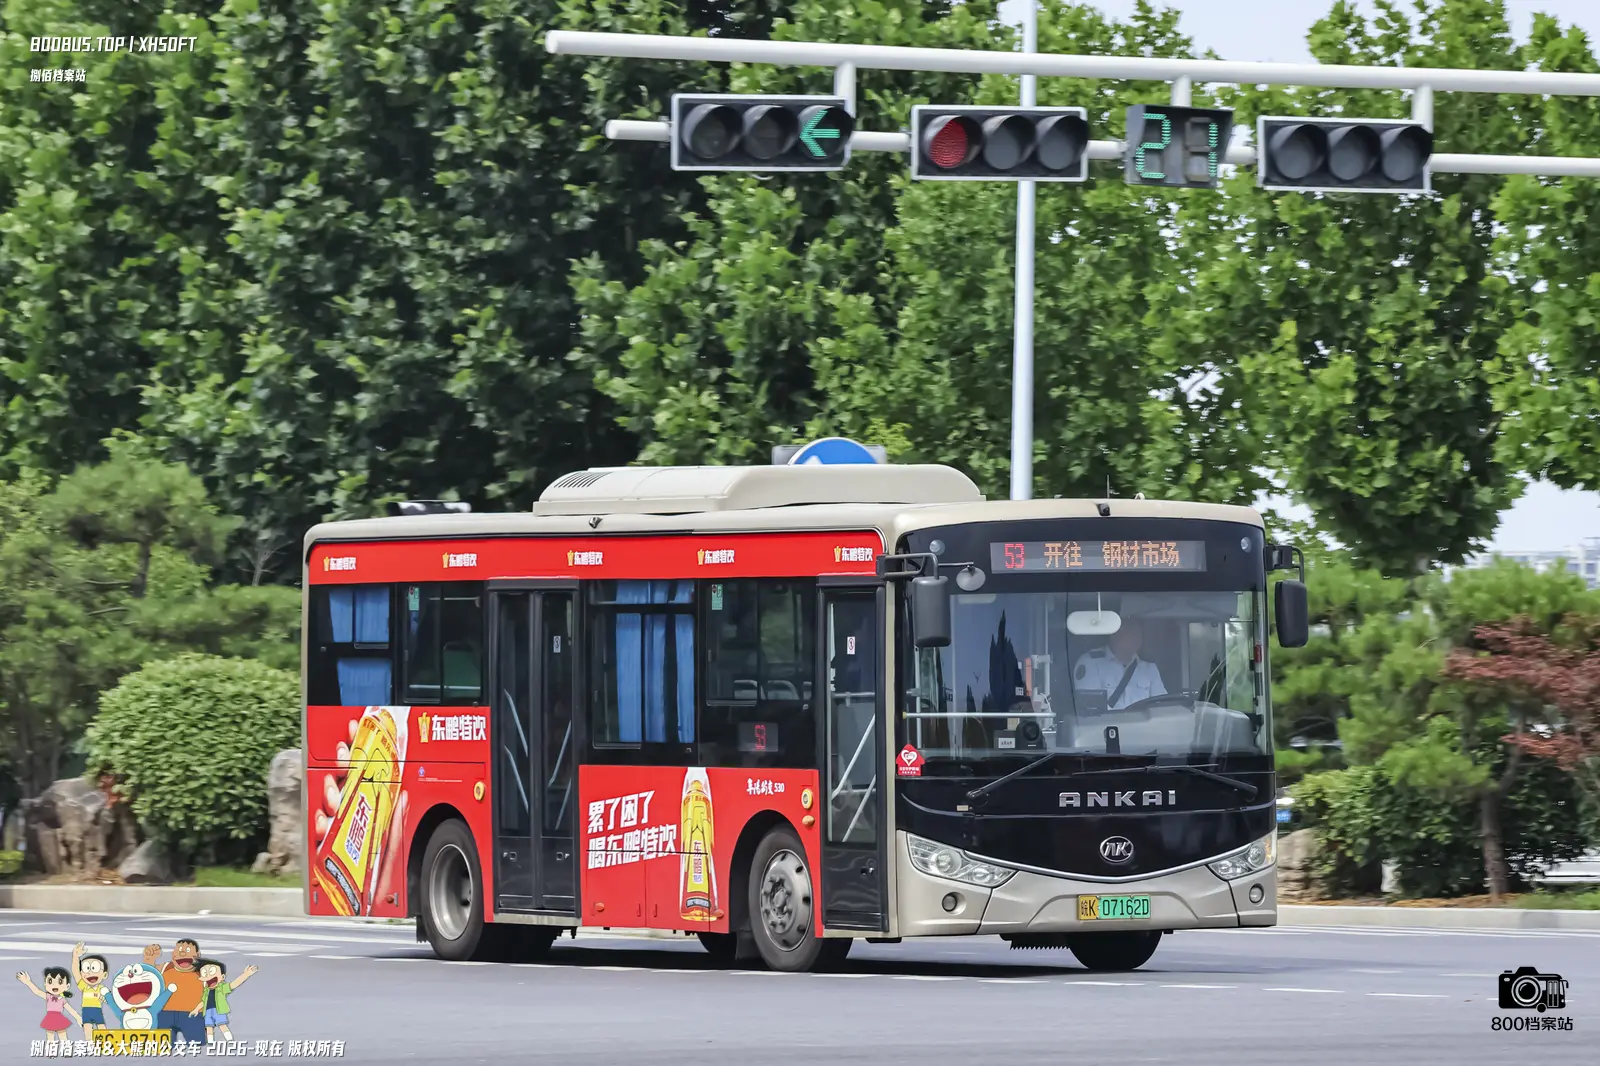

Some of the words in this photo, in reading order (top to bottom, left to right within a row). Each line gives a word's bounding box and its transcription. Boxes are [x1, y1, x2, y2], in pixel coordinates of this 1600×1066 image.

[1135, 112, 1219, 178] 21
[1004, 543, 1025, 569] 53
[1043, 541, 1083, 569] 开往
[1102, 540, 1181, 568] 钢材市场
[431, 714, 486, 741] 东鹏特饮
[587, 790, 656, 835] 累了困了
[1059, 790, 1176, 808] ANKAI
[587, 823, 678, 870] 喝东鹏特饮
[1102, 898, 1150, 916] 07162D
